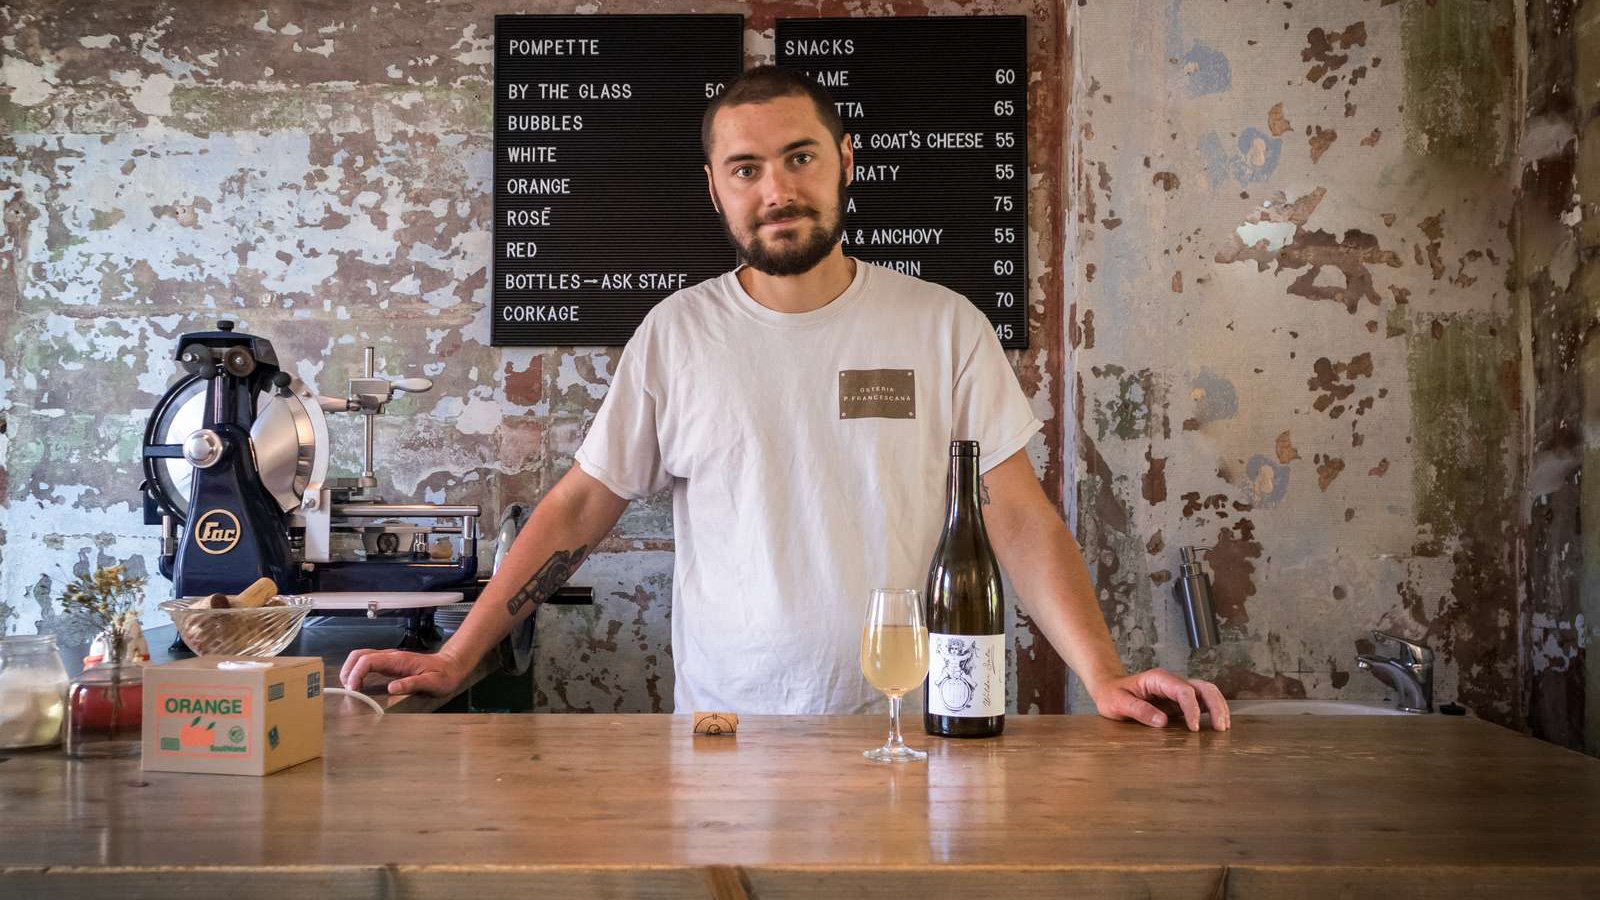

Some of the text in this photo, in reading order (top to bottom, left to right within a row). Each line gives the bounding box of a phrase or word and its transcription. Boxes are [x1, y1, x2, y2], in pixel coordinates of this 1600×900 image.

[509, 39, 600, 56] POMPETTE
[784, 39, 855, 56] SNACKS
[806, 68, 1016, 87] AME 60
[508, 83, 529, 100] BY
[537, 83, 569, 100] THE
[578, 83, 632, 100] GLASS
[834, 100, 1014, 118] TTA 65
[508, 115, 583, 131] BUBBLES
[852, 129, 1015, 149] & GOAT'S CHEESE 55
[507, 146, 557, 163] WHITE
[855, 164, 1015, 182] RATY 55
[506, 178, 571, 195] ORANGE
[993, 195, 1013, 212] 75
[854, 229, 865, 245] &
[870, 228, 943, 245] ANCHOVY
[994, 227, 1015, 244] 55
[506, 241, 538, 259] RED
[993, 259, 1014, 276] 60
[505, 273, 688, 290] BOTTLES ASK STAFF
[995, 291, 1014, 308] 70
[502, 305, 580, 322] CORKAGE
[995, 323, 1014, 340] 45
[165, 698, 243, 715] ORANGE
